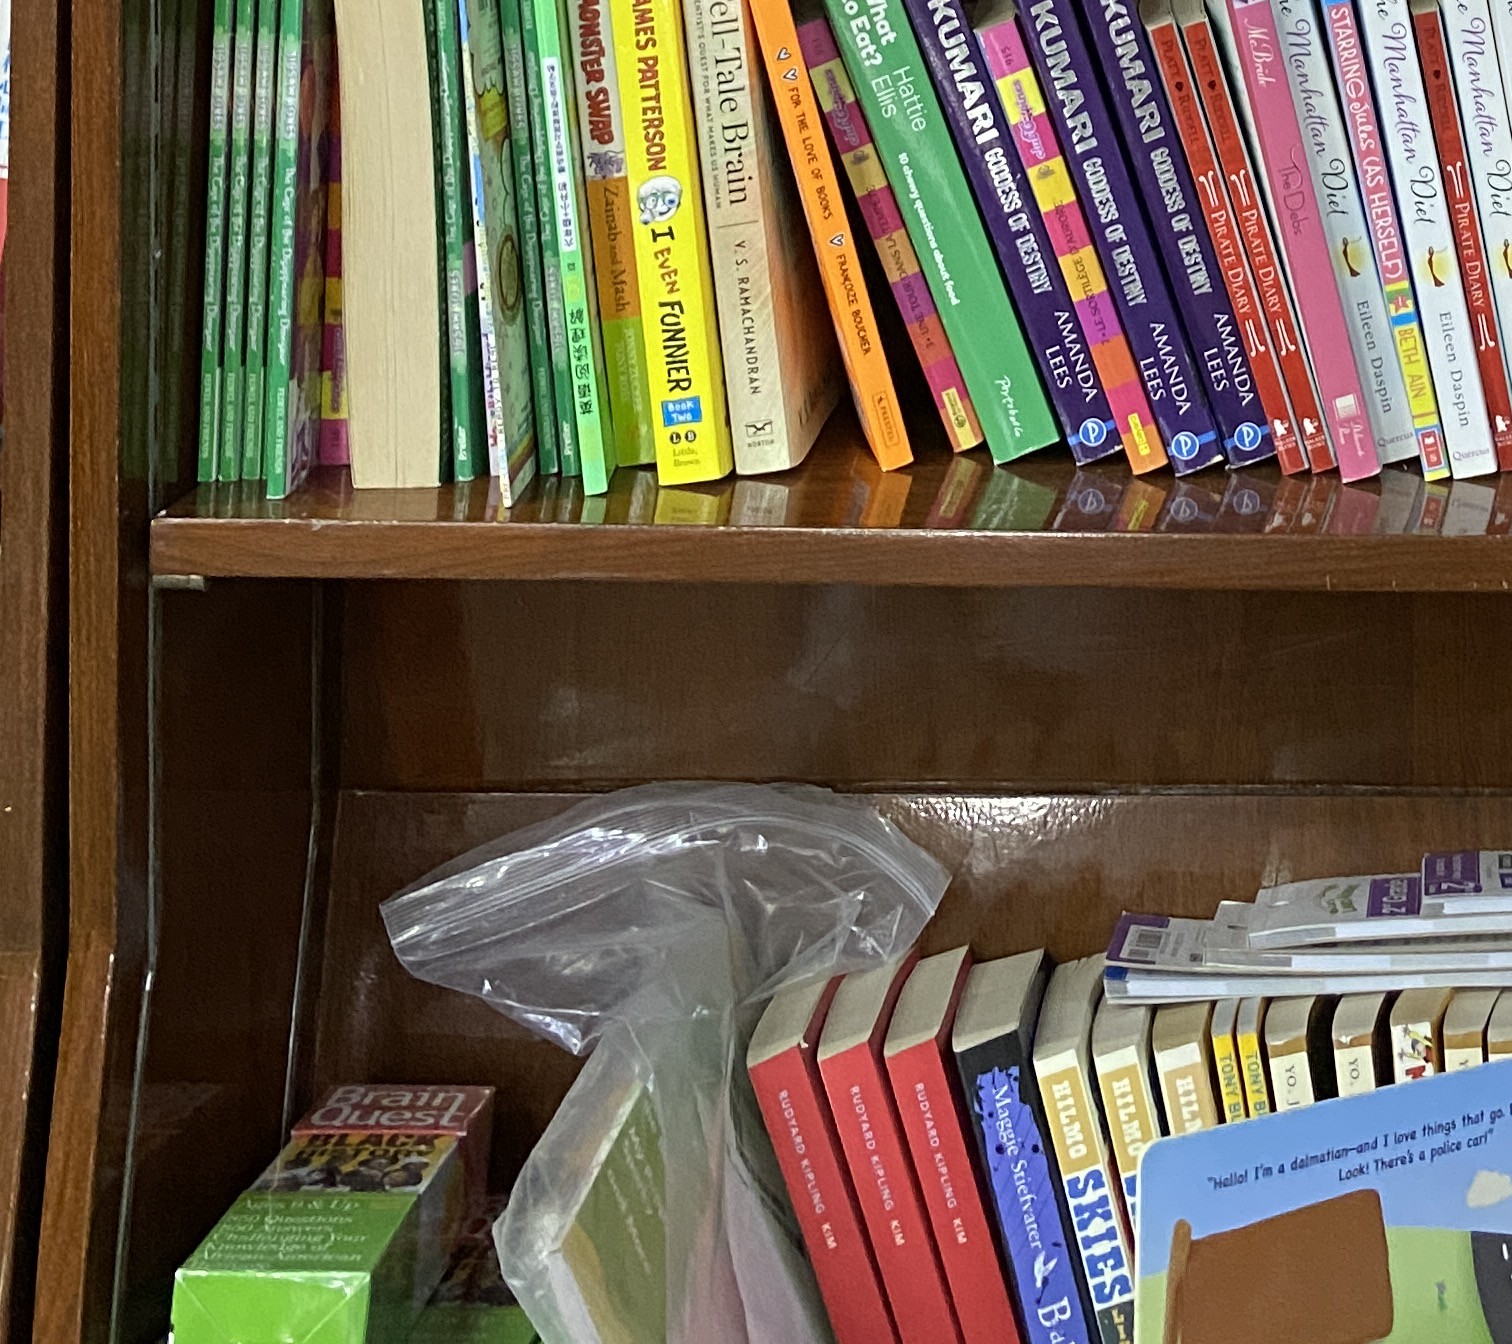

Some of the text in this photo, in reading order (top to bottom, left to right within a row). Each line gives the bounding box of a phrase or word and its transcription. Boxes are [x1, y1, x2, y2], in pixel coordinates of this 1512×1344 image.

[849, 12, 883, 67] Eat?
[871, 74, 897, 119] Ellis
[635, 53, 666, 172] PATTERSON
[788, 86, 833, 221] FOR THE LOVE OF BOOKS
[893, 66, 926, 133] Hattie
[1282, 17, 1329, 161] Manhattan
[1321, 157, 1348, 218] Diet
[1330, 7, 1363, 98] STARRING
[1368, 184, 1403, 280] HERSELF)
[721, 119, 750, 208] Brain
[984, 146, 1023, 215] GODDESS
[1007, 207, 1032, 237] OF
[651, 225, 691, 393] I EVEN FUNNIER
[1210, 209, 1252, 314] PIRATE DIARY
[737, 277, 762, 395] RAMACHANDRAN
[1054, 310, 1097, 403] AMANDA
[1355, 299, 1394, 415] Eileen Daspin
[309, 1108, 465, 1127] Quest
[326, 1086, 466, 1107] Brain
[778, 1090, 837, 1250] RUDYARD KIPLING KIM
[992, 1084, 1044, 1249] Maggie Stiefvater
[1066, 1169, 1135, 1305] SKIES
